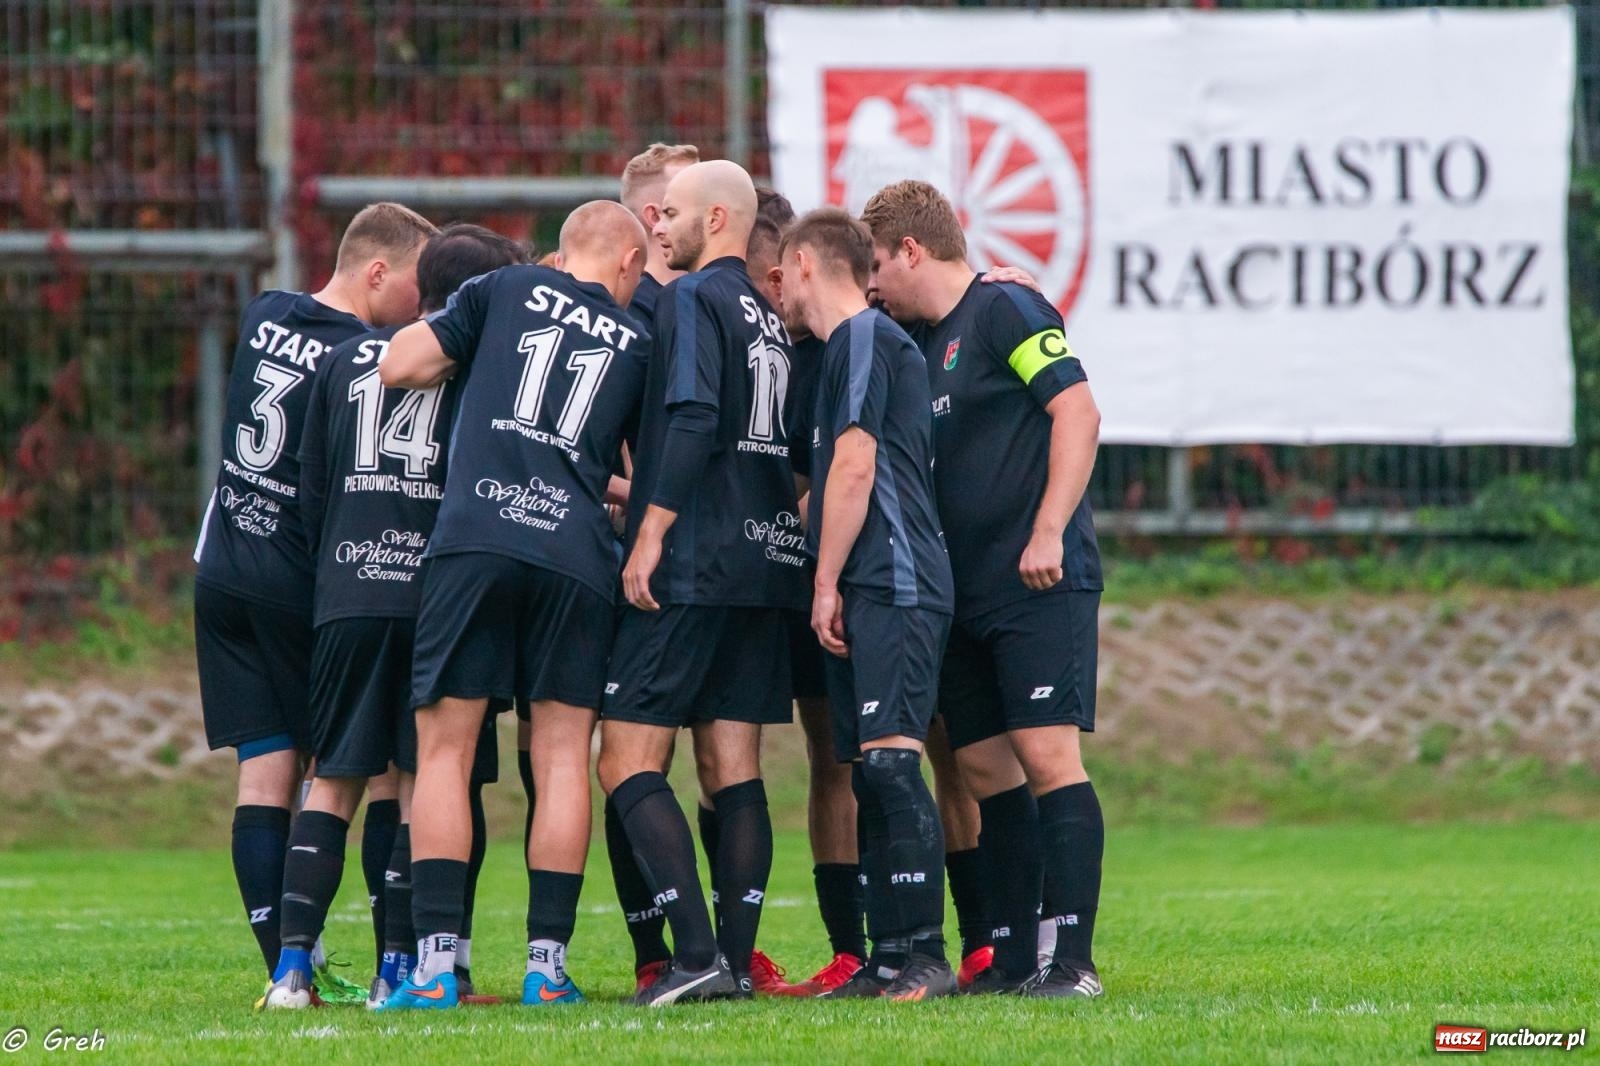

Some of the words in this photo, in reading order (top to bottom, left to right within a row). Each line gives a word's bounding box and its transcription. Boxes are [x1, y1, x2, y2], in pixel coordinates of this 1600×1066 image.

[1169, 137, 1491, 206] MIASTO
[1112, 223, 1546, 309] RACIBÓRZ
[525, 285, 637, 351] START
[249, 320, 333, 372] STAR
[1039, 332, 1067, 358] C
[514, 325, 614, 447] 11
[236, 359, 304, 472] 3
[348, 367, 440, 479] 14
[491, 418, 549, 444] PIETROWICE
[258, 476, 297, 498] WIELKIE
[345, 474, 401, 493] PIETROWICE
[529, 476, 570, 503] Willa
[475, 478, 569, 520] Wiktoria
[499, 505, 559, 532] Brenna
[381, 529, 427, 547] Willa
[335, 541, 424, 567] Wiktoria
[357, 564, 415, 582] Brenna
